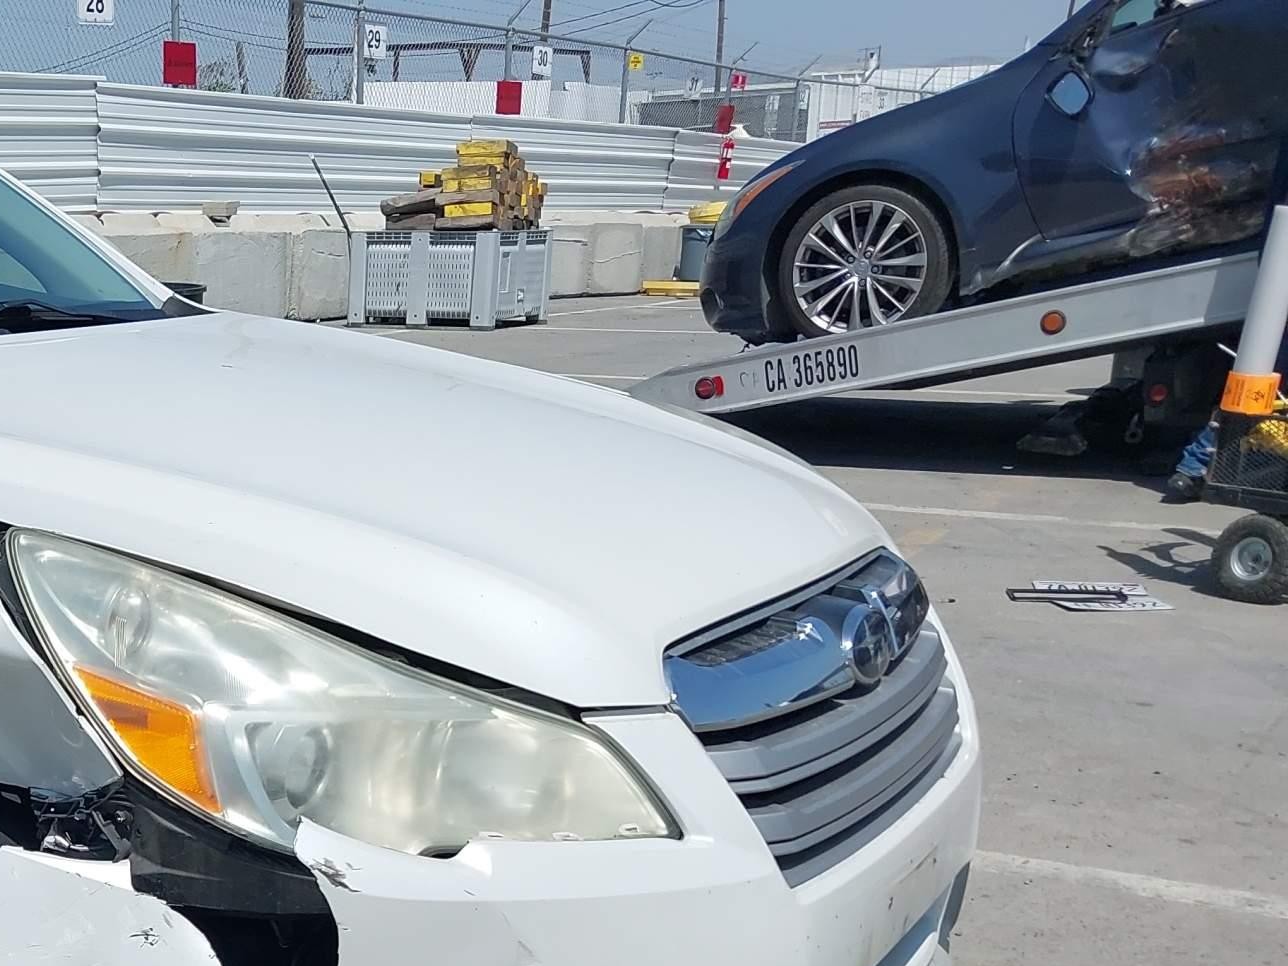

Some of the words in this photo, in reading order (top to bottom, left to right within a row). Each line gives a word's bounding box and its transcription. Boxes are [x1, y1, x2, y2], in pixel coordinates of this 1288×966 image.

[86, 0, 104, 13] 28
[367, 29, 381, 49] 29
[537, 50, 548, 67] 30
[764, 358, 787, 392] CA
[792, 344, 859, 388] 365890
